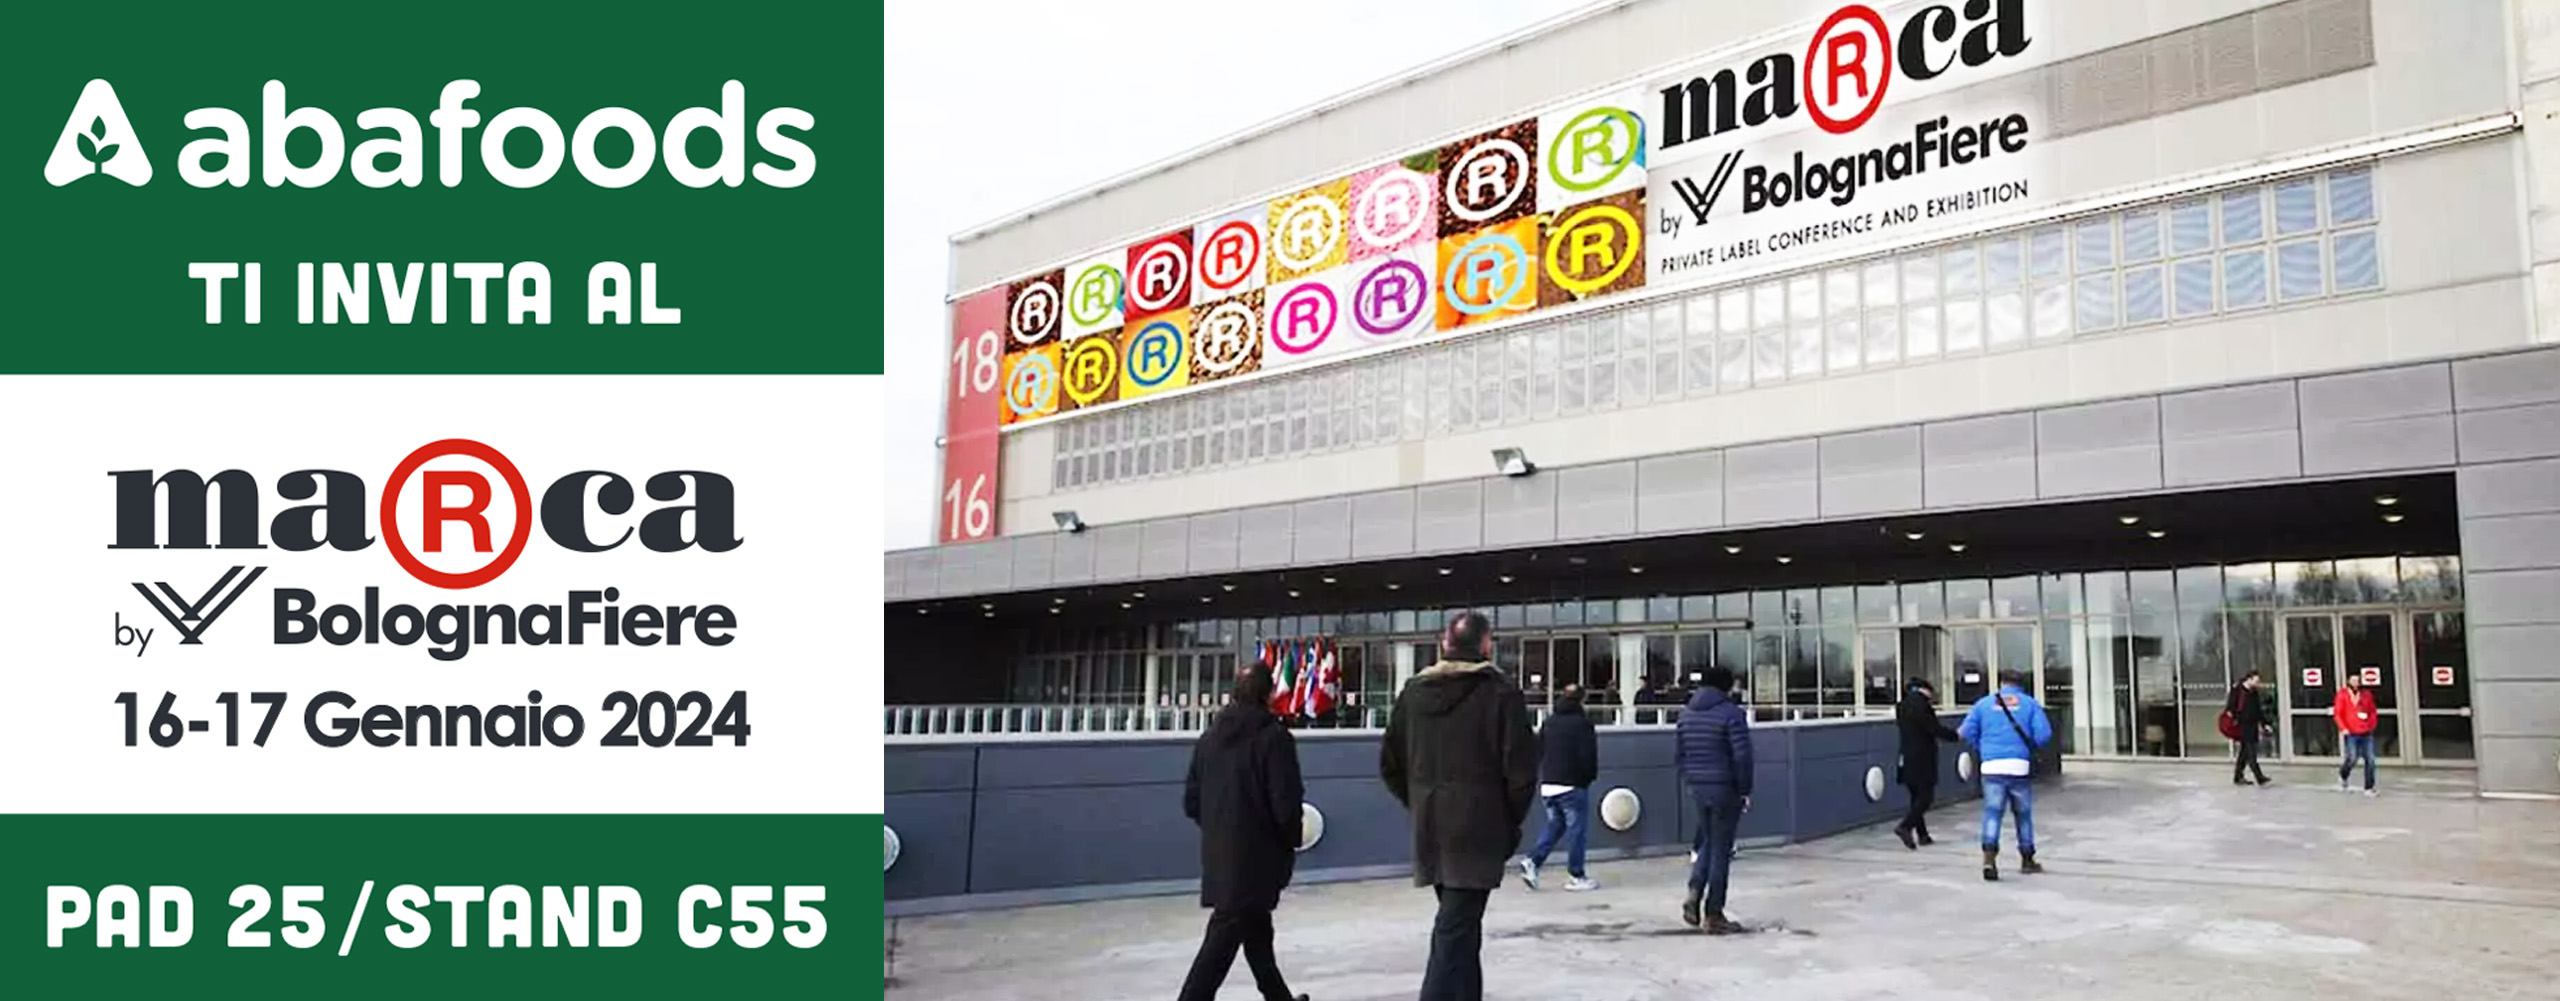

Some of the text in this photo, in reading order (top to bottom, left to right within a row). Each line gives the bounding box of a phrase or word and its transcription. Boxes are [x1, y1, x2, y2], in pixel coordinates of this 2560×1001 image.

[1660, 113, 2029, 240] by BolognaFiere
[1661, 179, 2028, 275] PRIVATE LABEL CONFERENCE AND EXHIBITION
[953, 330, 998, 397] 18
[945, 474, 990, 539] 16
